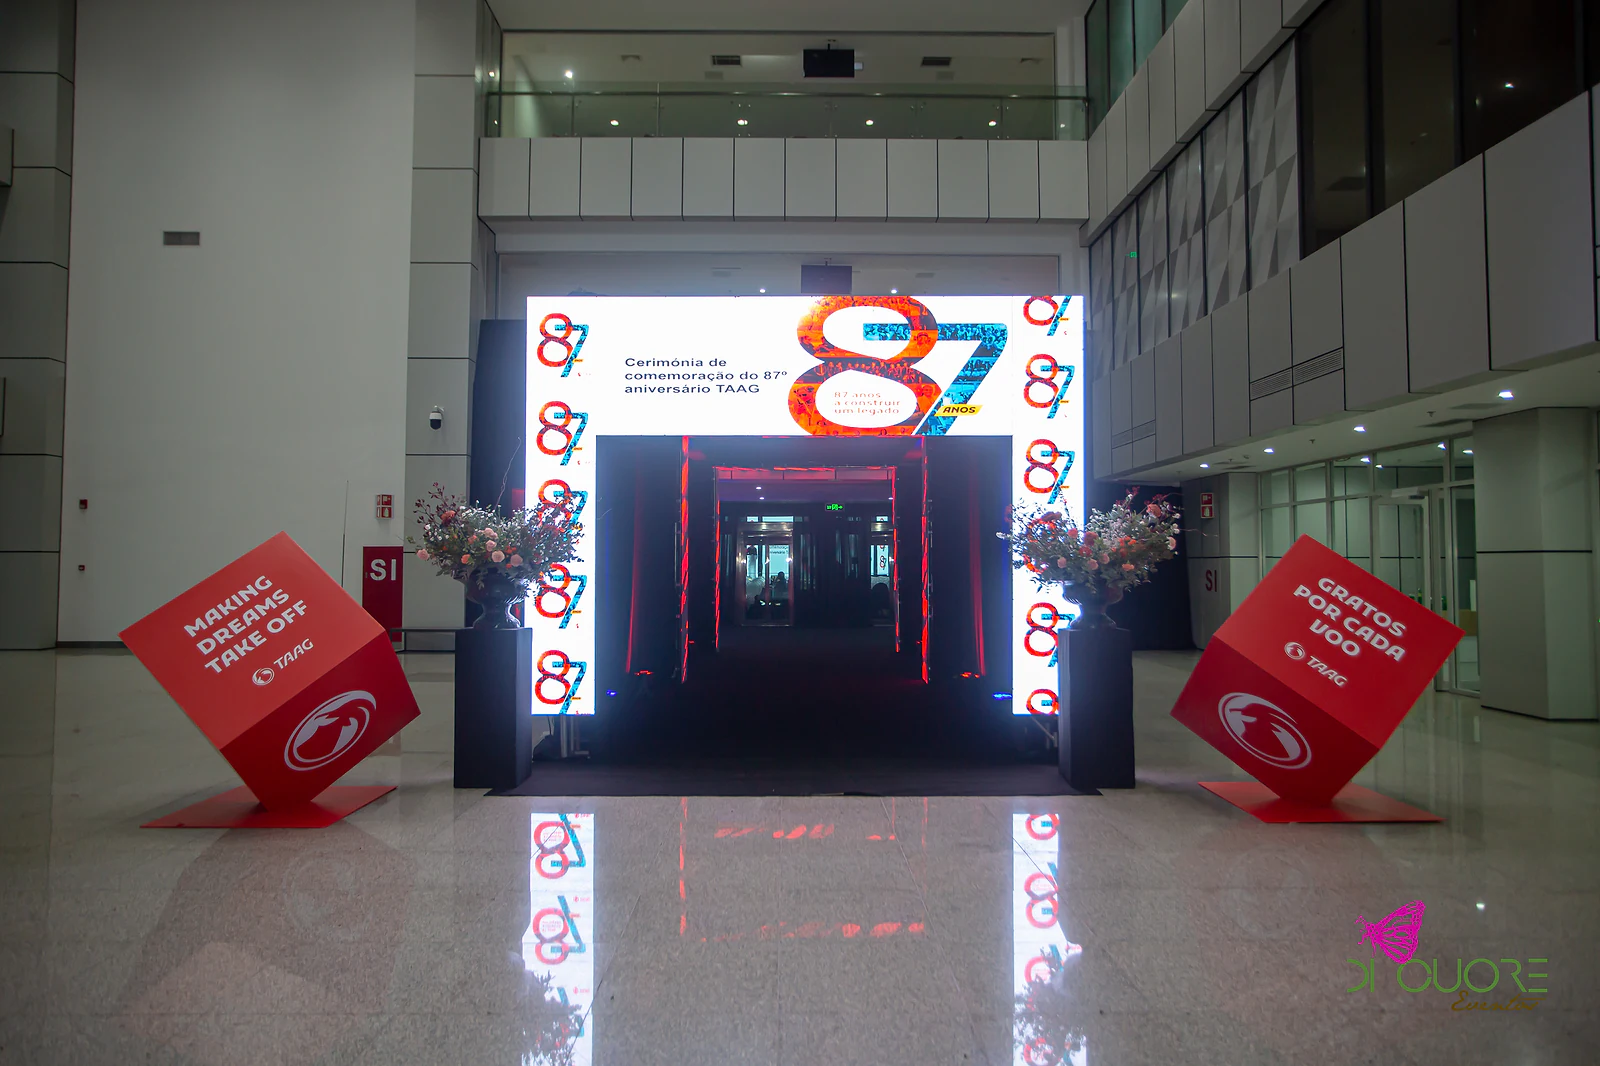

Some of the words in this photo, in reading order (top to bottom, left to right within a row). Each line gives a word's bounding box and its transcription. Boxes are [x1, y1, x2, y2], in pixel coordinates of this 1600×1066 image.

[537, 313, 589, 377] 87
[625, 357, 703, 367] Cerimónia
[709, 357, 727, 367] de
[625, 371, 735, 382] comemoração
[739, 370, 758, 380] do
[764, 370, 787, 380] 87º
[788, 295, 1008, 435] 87
[625, 384, 711, 394] aniversário
[716, 384, 760, 394] TAAG
[943, 406, 976, 414] ANOS
[1023, 354, 1075, 418] 87
[536, 401, 588, 465] 87
[1024, 439, 1075, 504] 87
[370, 559, 396, 581] SI
[535, 564, 587, 629] 87
[1205, 569, 1217, 592] SI
[184, 575, 273, 638] MAKING
[196, 588, 290, 656] DREAMS
[204, 630, 267, 674] TAKE
[266, 599, 308, 634] OFF
[1293, 584, 1342, 622] POR
[1343, 616, 1406, 662] CADA
[1309, 619, 1361, 657] VOO
[1318, 577, 1407, 638] GRATOS
[273, 638, 314, 669] TAAG
[535, 650, 587, 714] 87
[1306, 656, 1347, 687] TAAG
